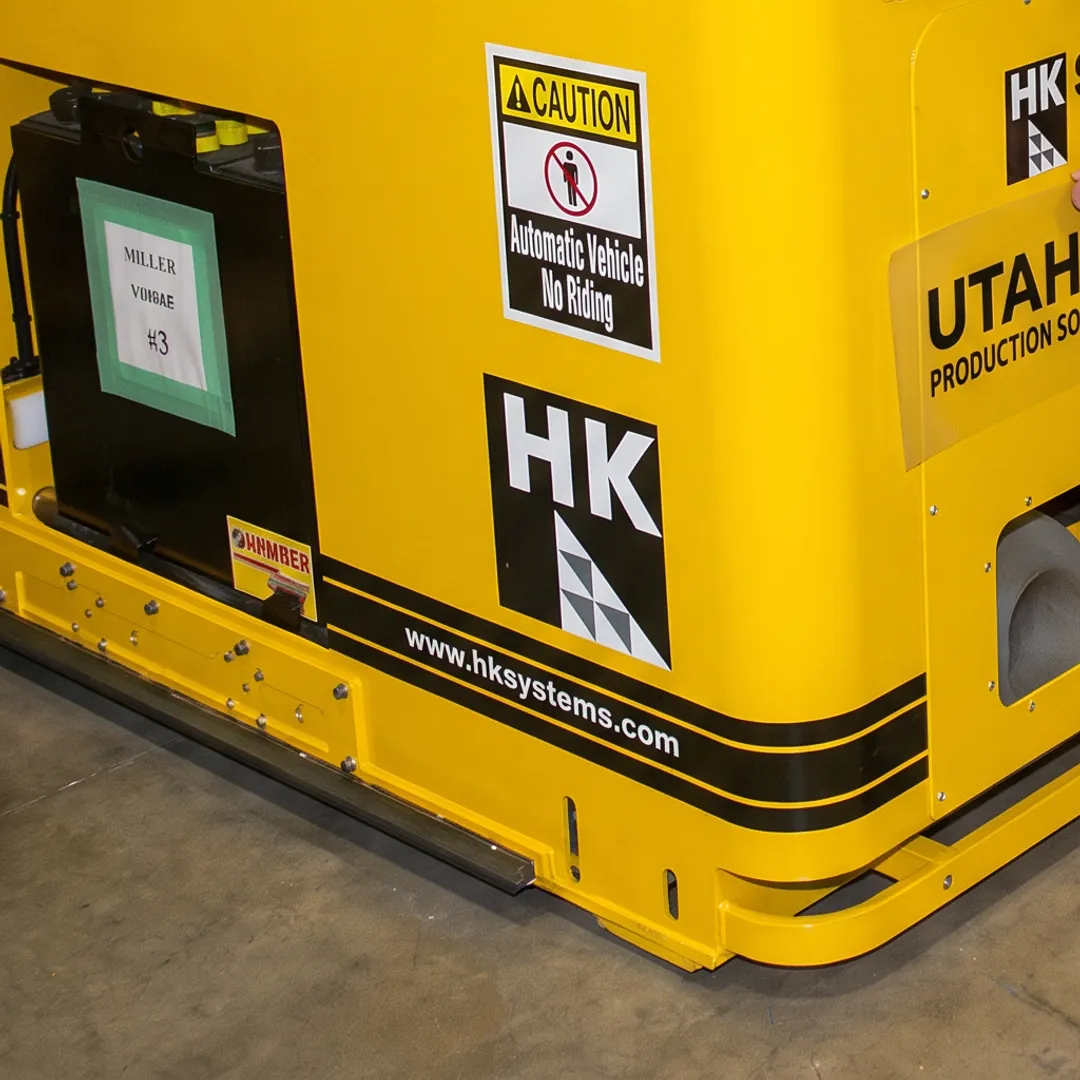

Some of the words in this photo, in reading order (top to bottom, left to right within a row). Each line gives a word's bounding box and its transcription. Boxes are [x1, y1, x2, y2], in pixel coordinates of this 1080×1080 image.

[532, 76, 631, 135] CAUTION
[1010, 57, 1066, 121] HK
[124, 247, 176, 275] MILLER
[510, 213, 585, 271] Automatic
[587, 232, 644, 287] Vehicle
[541, 267, 563, 311] No
[568, 275, 613, 333] Riding
[928, 232, 1080, 350] UTAH
[147, 329, 169, 356] #3
[930, 320, 1053, 398] PRODUCTION
[503, 392, 663, 538] HK
[405, 627, 680, 758] www.hksystems.com
